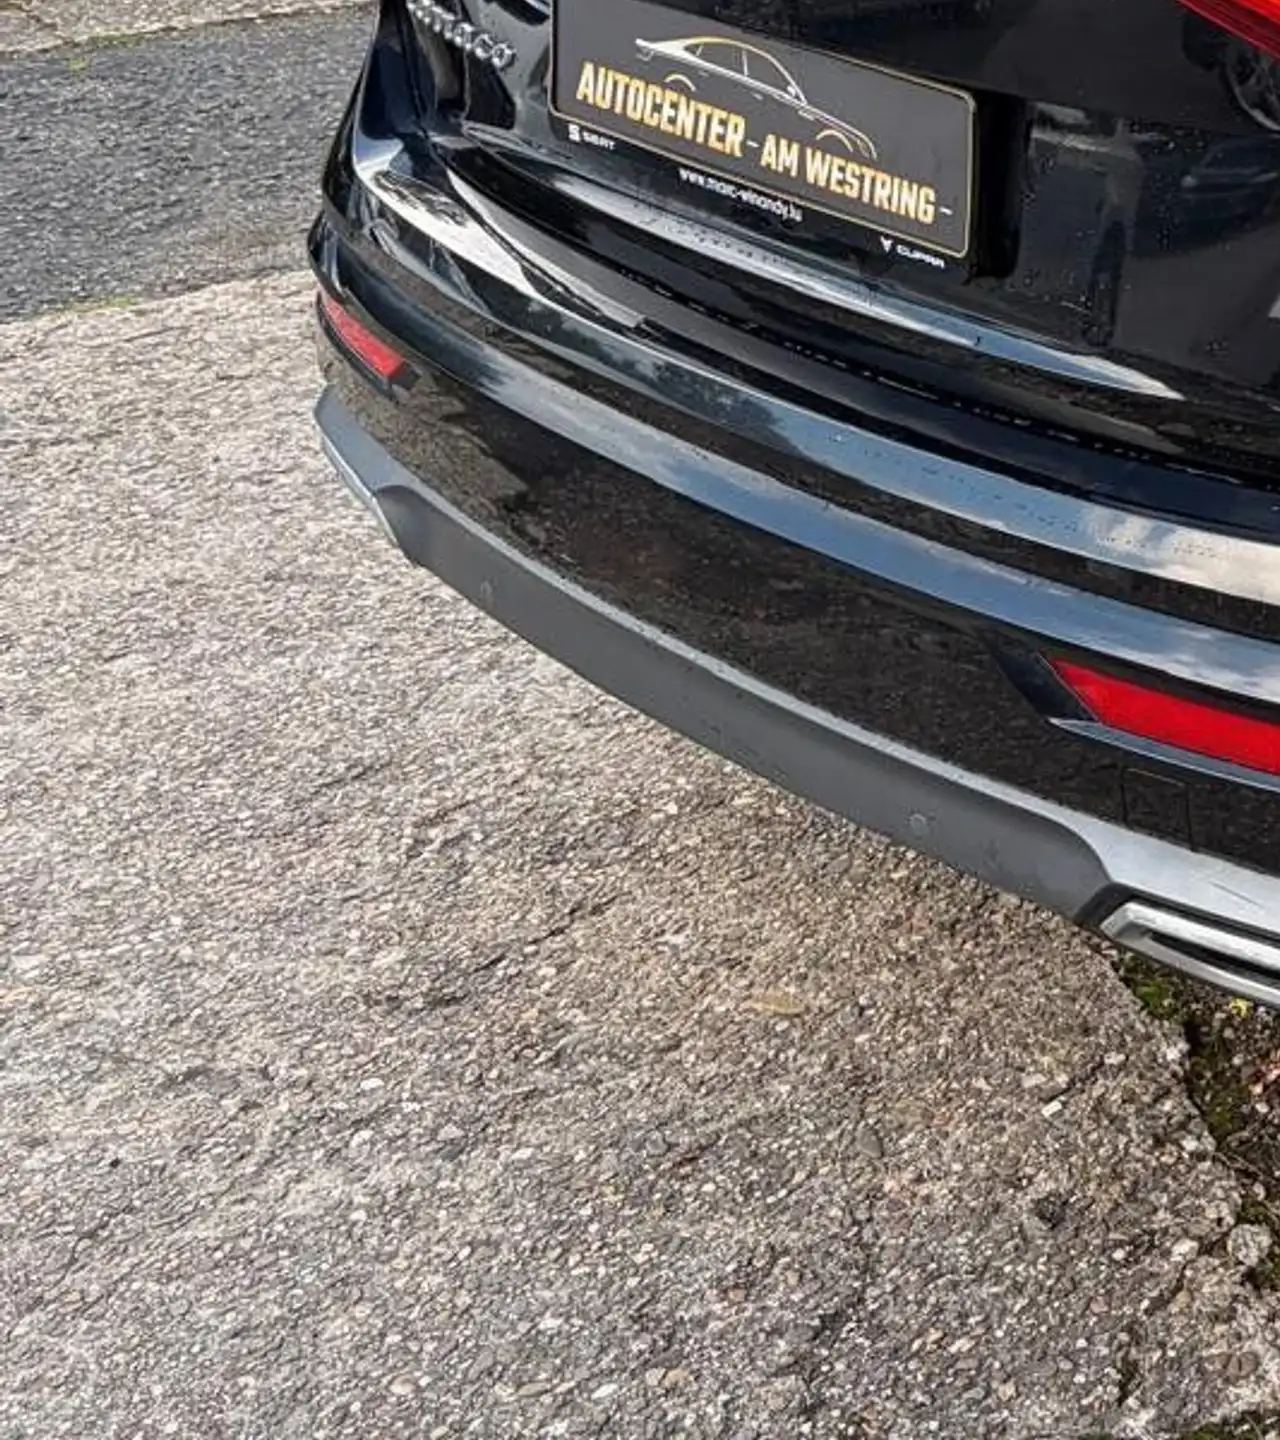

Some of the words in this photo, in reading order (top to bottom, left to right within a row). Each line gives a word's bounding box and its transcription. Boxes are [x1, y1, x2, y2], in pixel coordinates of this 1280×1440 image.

[575, 62, 746, 157] AUTOCENTER
[761, 134, 801, 177] AM
[805, 147, 935, 225] WESTRING
